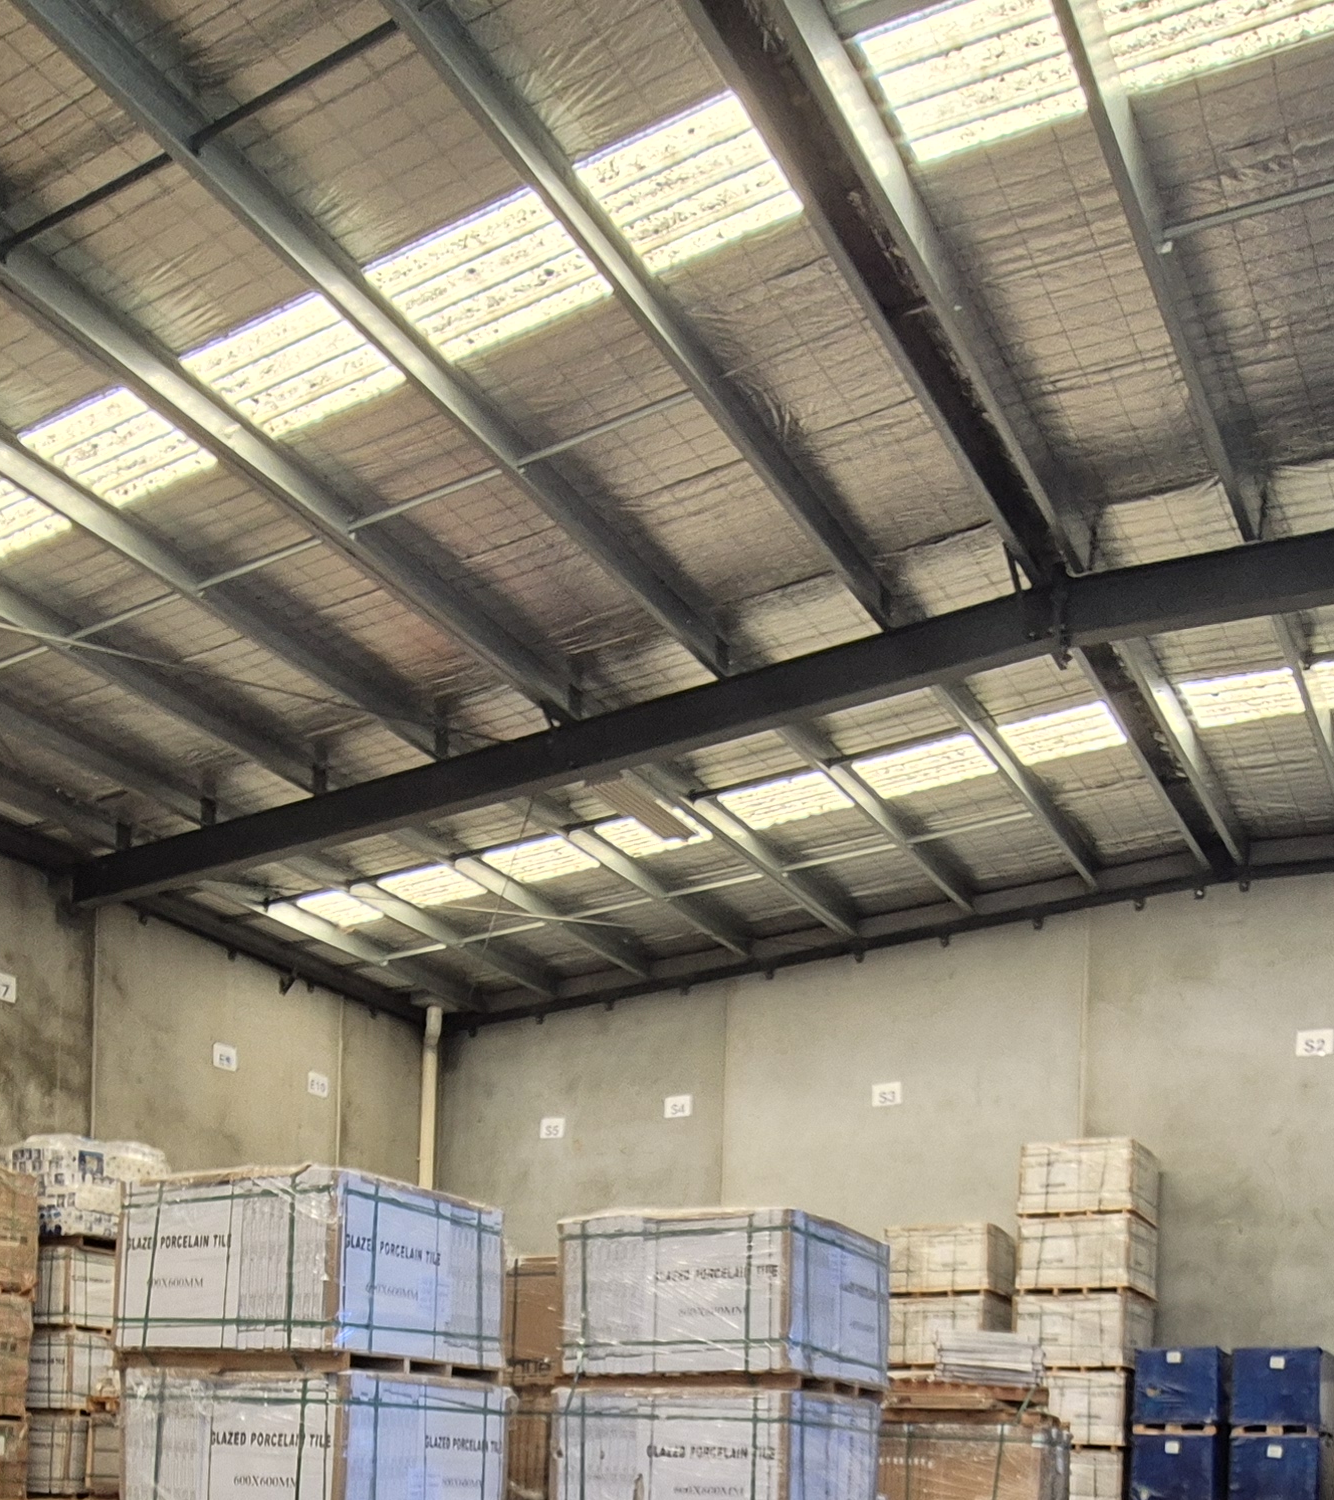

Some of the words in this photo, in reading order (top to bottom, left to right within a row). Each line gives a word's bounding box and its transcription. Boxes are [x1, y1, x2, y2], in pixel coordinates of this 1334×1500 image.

[1304, 1038, 1326, 1054] S2
[878, 1090, 896, 1104] S3
[545, 1125, 559, 1136] S5
[127, 1233, 158, 1250] GLAZE
[160, 1235, 210, 1250] PORCELAIN
[345, 1233, 374, 1252] GLAZE
[380, 1241, 423, 1262] PORCELAIN
[425, 1251, 442, 1266] TILE
[211, 1430, 247, 1446] GLAZED
[309, 1434, 331, 1449] TILE
[425, 1434, 451, 1449] GLAZED
[689, 1446, 748, 1460] PORCELAIN
